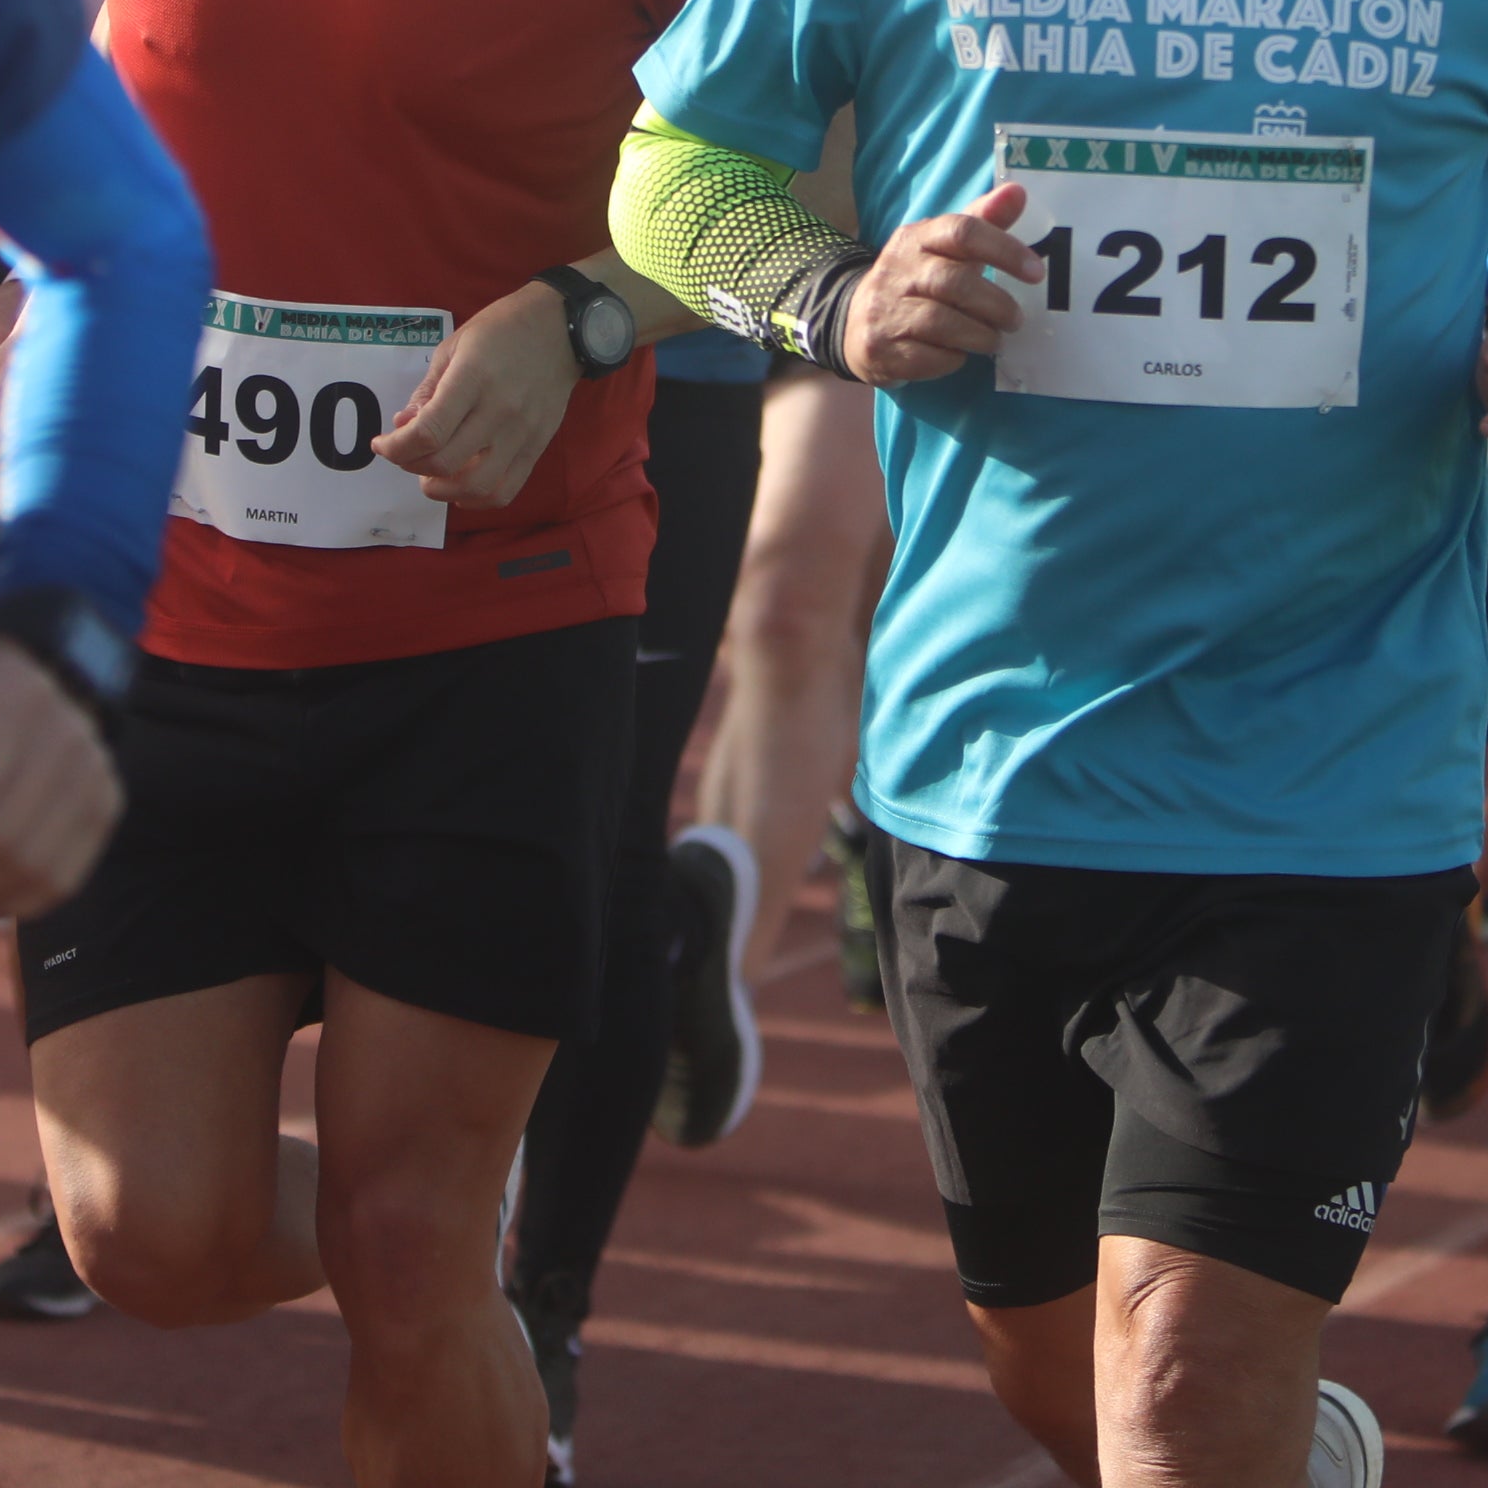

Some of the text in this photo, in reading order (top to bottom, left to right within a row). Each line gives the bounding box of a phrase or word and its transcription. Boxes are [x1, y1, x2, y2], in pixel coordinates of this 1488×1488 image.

[949, 11, 1438, 98] BAHÍA DE CÁDIZ
[1186, 146, 1253, 163] MEDIA
[1184, 160, 1362, 181] BAHÍA DE CÁDIZ
[1028, 226, 1317, 322] 1212
[280, 312, 340, 328] MEDIA
[280, 324, 440, 344] BAHÍA DE CÁDIZ
[1143, 362, 1202, 377] CARLOS
[184, 365, 382, 471] 490
[245, 507, 298, 524] MARTIN
